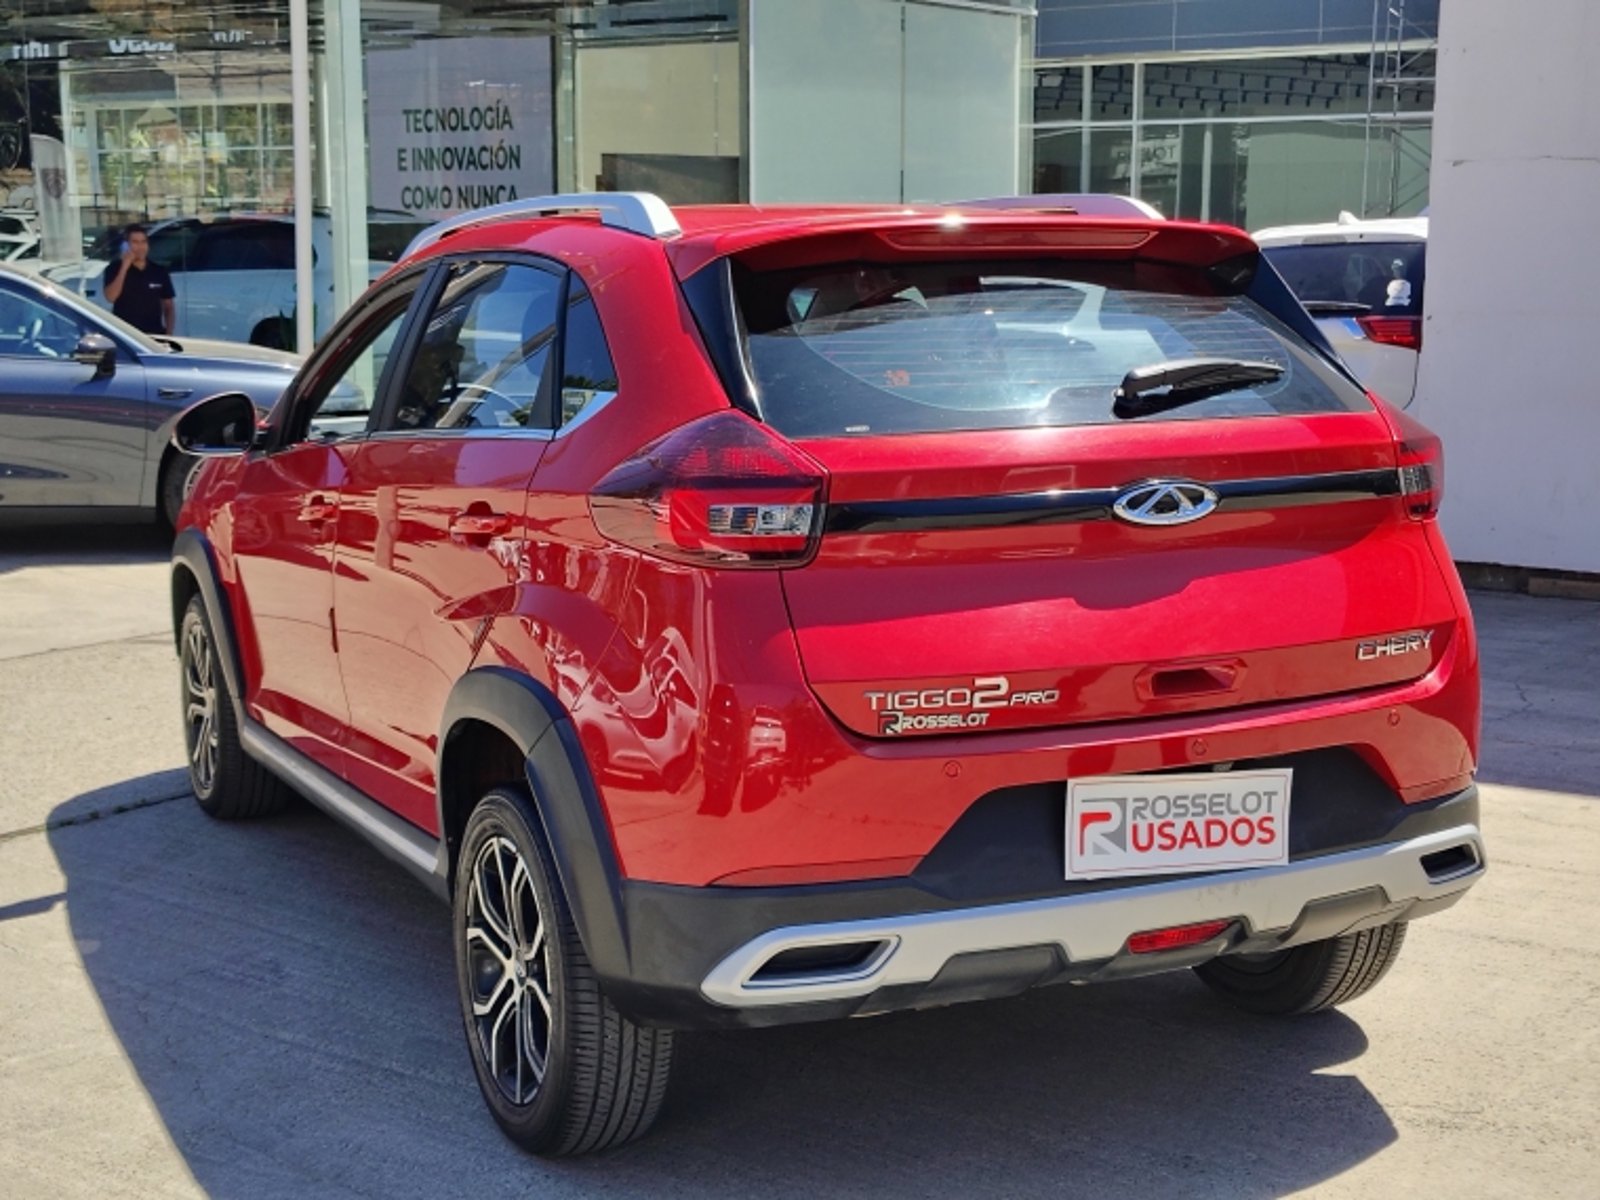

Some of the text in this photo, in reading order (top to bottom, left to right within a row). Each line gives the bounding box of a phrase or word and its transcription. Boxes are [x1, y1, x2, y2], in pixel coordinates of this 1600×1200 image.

[402, 99, 514, 132] TECNOLOGÍA
[398, 140, 521, 171] E INNOVACIÓN
[401, 185, 519, 209] COMO NUNCA
[1357, 629, 1435, 661] CHERY
[1009, 690, 1060, 706] PRO
[1132, 791, 1278, 821] ROSSELOT
[1132, 816, 1277, 852] USADOS
